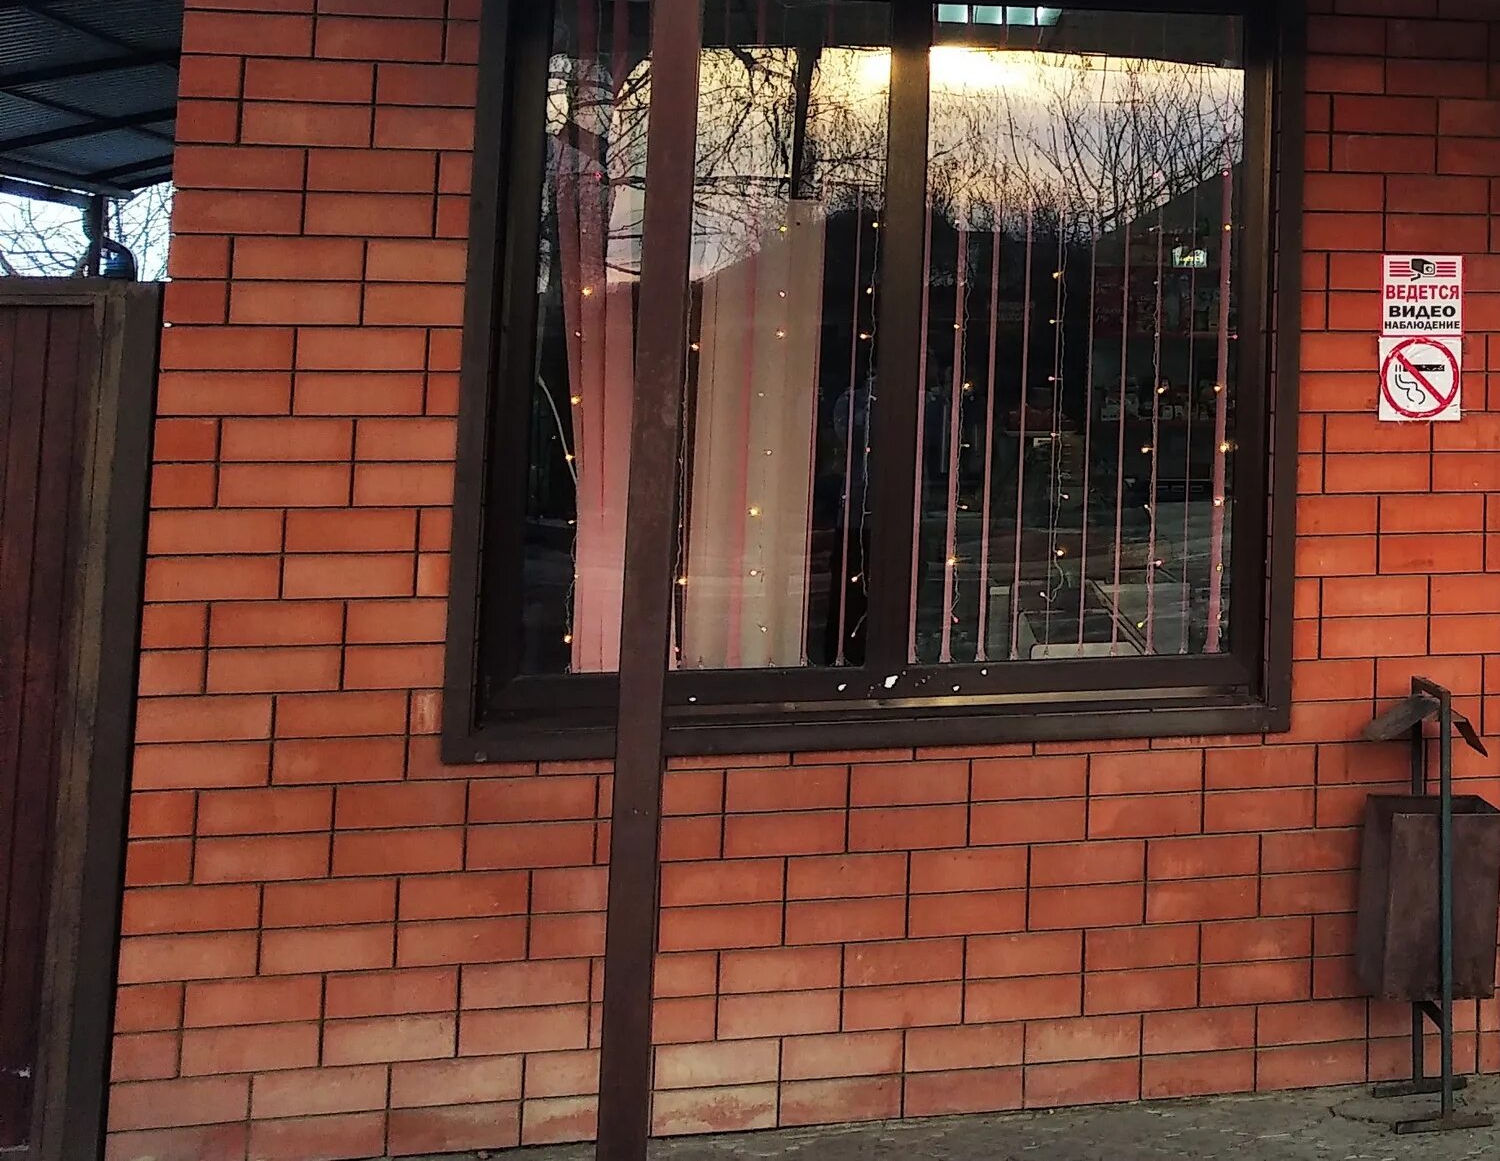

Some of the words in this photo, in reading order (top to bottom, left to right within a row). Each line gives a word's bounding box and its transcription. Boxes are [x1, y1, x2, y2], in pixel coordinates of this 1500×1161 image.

[1386, 284, 1459, 302] ВЕДЕТСЯ
[1389, 305, 1456, 319] ВИДЕО
[1385, 320, 1460, 330] НАБЛЮДЕНИЕ
